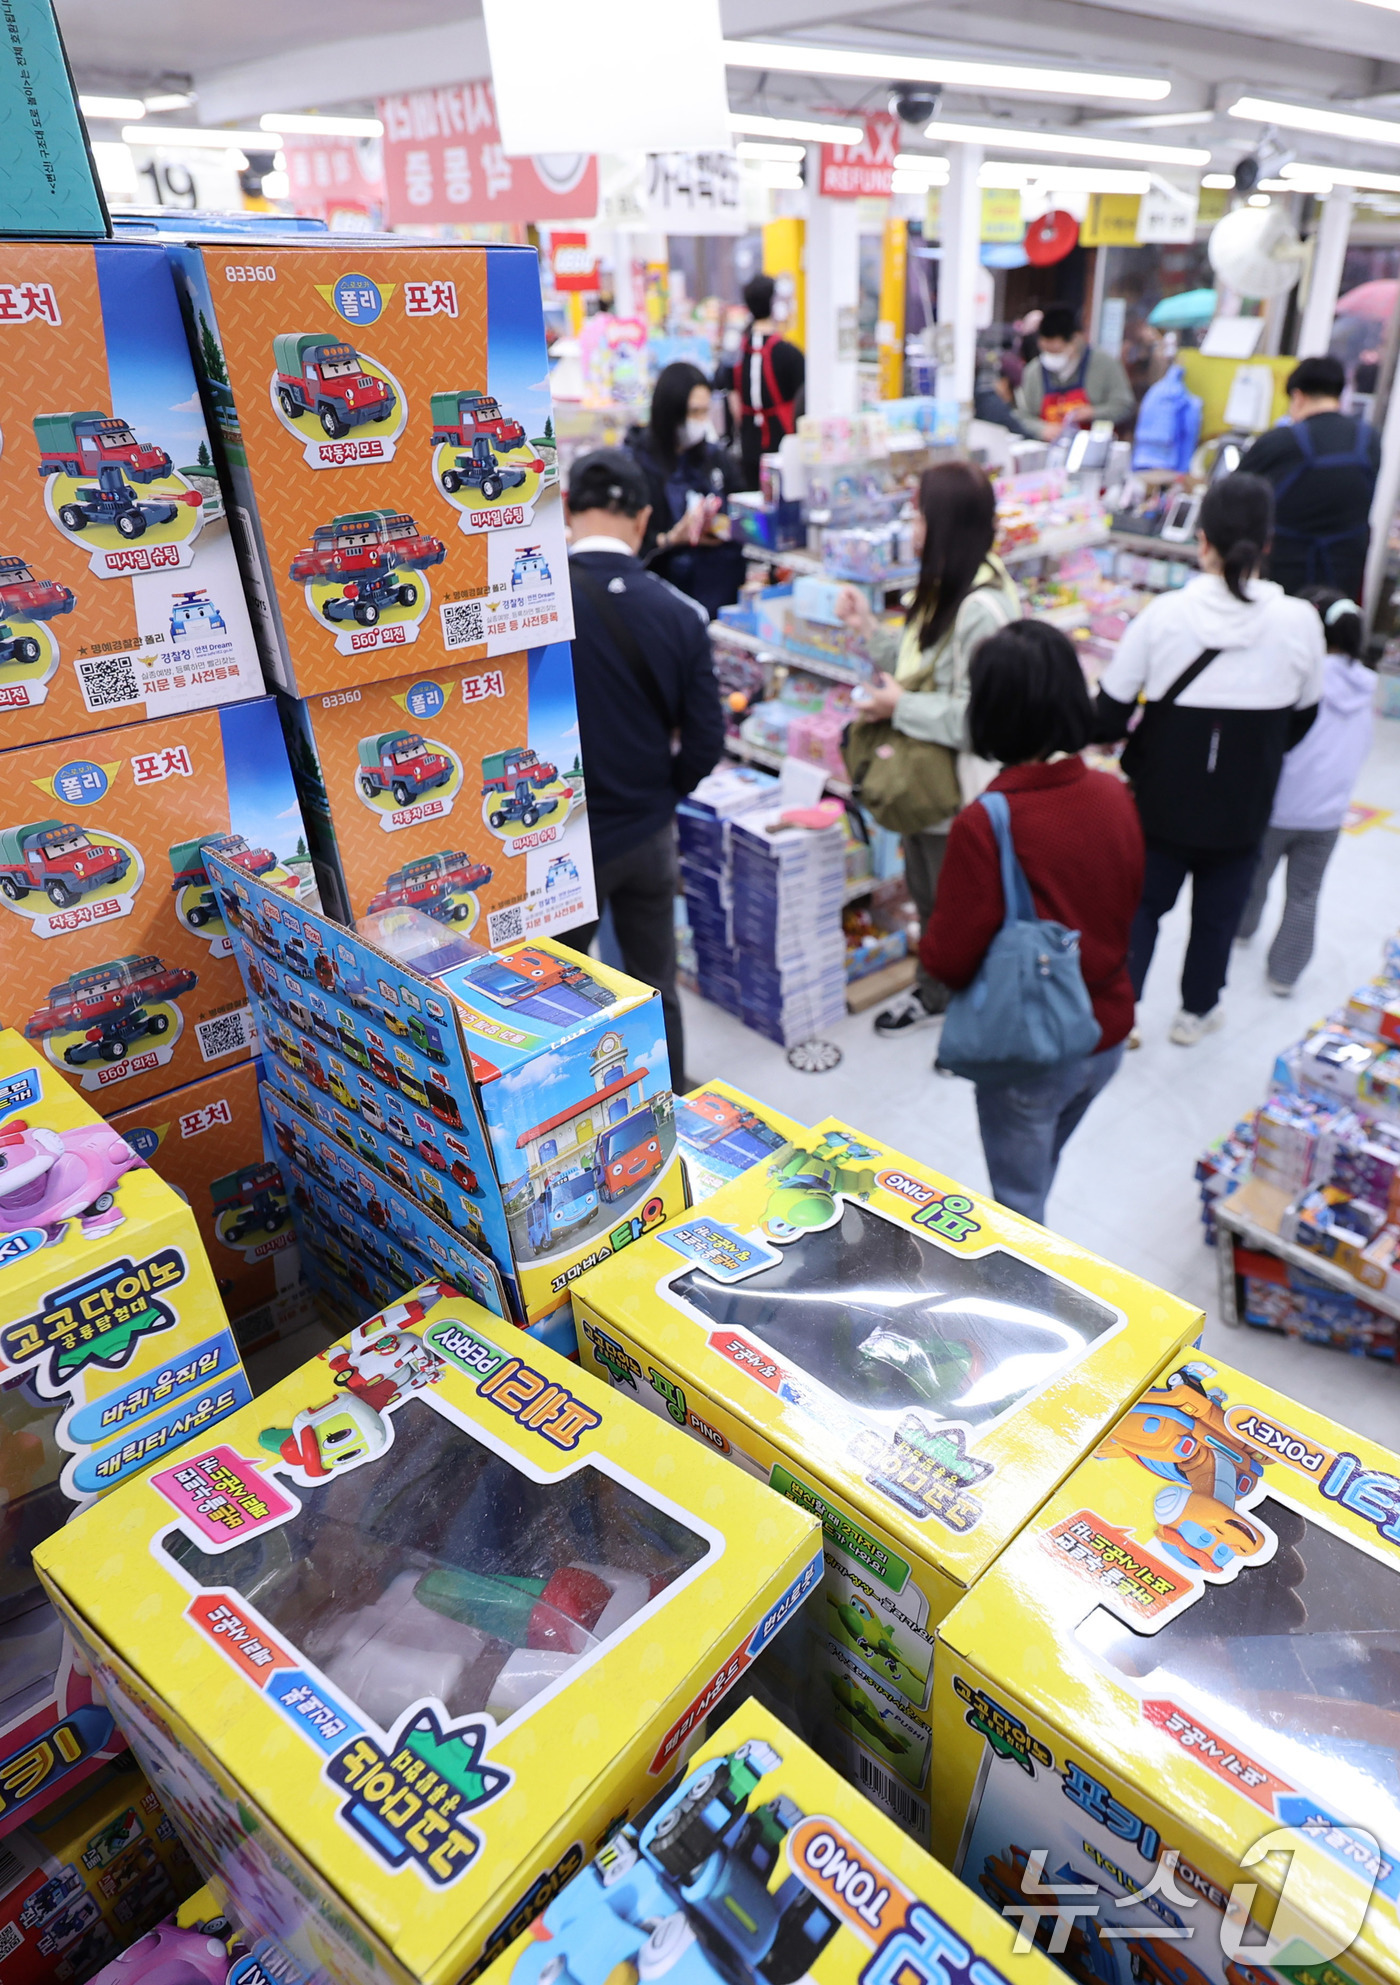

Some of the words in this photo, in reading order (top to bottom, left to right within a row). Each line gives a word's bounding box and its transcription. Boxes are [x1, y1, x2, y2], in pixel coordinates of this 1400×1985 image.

[13, 46, 27, 67] 전체
[29, 109, 42, 129] 도로
[225, 265, 277, 282] 83360
[338, 288, 379, 319] 폴리
[404, 280, 460, 319] 포처
[319, 442, 359, 465] 자동차
[359, 440, 385, 460] 모드
[470, 509, 502, 528] 미사일
[503, 506, 525, 525] 슈팅
[104, 550, 151, 571] 미사일
[151, 545, 180, 565] 슈팅
[502, 597, 525, 610] 경찰청
[382, 624, 405, 645] 회전
[487, 622, 507, 636] 지문
[521, 611, 559, 628] 사전등록
[90, 638, 143, 653] 명예경찰관
[144, 634, 165, 646] 폴리
[161, 650, 191, 664] 경찰청
[194, 645, 208, 655] 안전
[209, 641, 233, 652] Dream
[142, 678, 171, 694] 지문
[173, 675, 186, 688] 등
[191, 664, 241, 684] 사전등록
[462, 671, 505, 703] 포처
[321, 689, 362, 709] 83360
[410, 692, 440, 715] 폴리
[132, 746, 193, 785] 포처
[60, 773, 102, 801] 폴리
[392, 808, 423, 825] 자동차
[423, 801, 444, 817] 모드
[512, 833, 539, 850] 미사일
[539, 827, 557, 843] 슈팅
[50, 909, 91, 931] 자동차
[91, 900, 121, 919] 모드
[98, 1059, 131, 1086] 360°
[131, 1053, 159, 1072] 회전
[180, 1100, 232, 1139] 포처
[885, 1173, 935, 1202] PING
[911, 1195, 981, 1243] 핑
[551, 1246, 613, 1293] 꼬마버스
[611, 1197, 665, 1252] 타요
[674, 1229, 709, 1254] 누르면
[734, 1250, 750, 1263] 핑
[6, 1258, 183, 1361] 고고다이노
[60, 1294, 149, 1350] 공룡탐험대
[433, 1325, 502, 1375] PERRY
[585, 1324, 642, 1375] 고고다이노
[726, 1340, 764, 1364] 사운드
[101, 1389, 149, 1428] 바퀴
[151, 1347, 221, 1401] 움직임
[477, 1357, 602, 1451] 페리
[650, 1369, 689, 1424] 핑
[687, 1415, 724, 1447] PING
[96, 1426, 169, 1478] 캐릭터
[169, 1389, 236, 1440] 사운드
[1237, 1415, 1326, 1471] POKEY
[174, 1467, 213, 1503] 누르면
[196, 1494, 246, 1531] 버튼을
[236, 1490, 271, 1519] 페리
[790, 1481, 828, 1515] 변신할
[826, 1512, 841, 1526] 때
[842, 1524, 889, 1563] 2가지의
[848, 1542, 887, 1576] 나와요!
[1053, 1532, 1106, 1573] 누르면
[1134, 1567, 1176, 1595] 포키
[762, 1564, 816, 1638] 변신로봇
[206, 1604, 249, 1642] 사운드
[880, 1596, 935, 1644] 굴러가요!
[239, 1636, 275, 1667] 페리
[280, 1684, 346, 1740] 변신로봇
[663, 1713, 694, 1758] 페리
[695, 1656, 741, 1718] 사운드
[956, 1681, 1052, 1765] 고고다이노
[895, 1714, 925, 1741] PUSH!
[1162, 1711, 1225, 1753] 사운드
[389, 1748, 463, 1818] 공룡탐험대
[1221, 1756, 1268, 1787] 포키
[342, 1739, 477, 1880] 고고다이노
[1066, 1762, 1166, 1862] 포키
[1298, 1811, 1395, 1880] 변신로봇
[803, 1831, 893, 1929] TOMO
